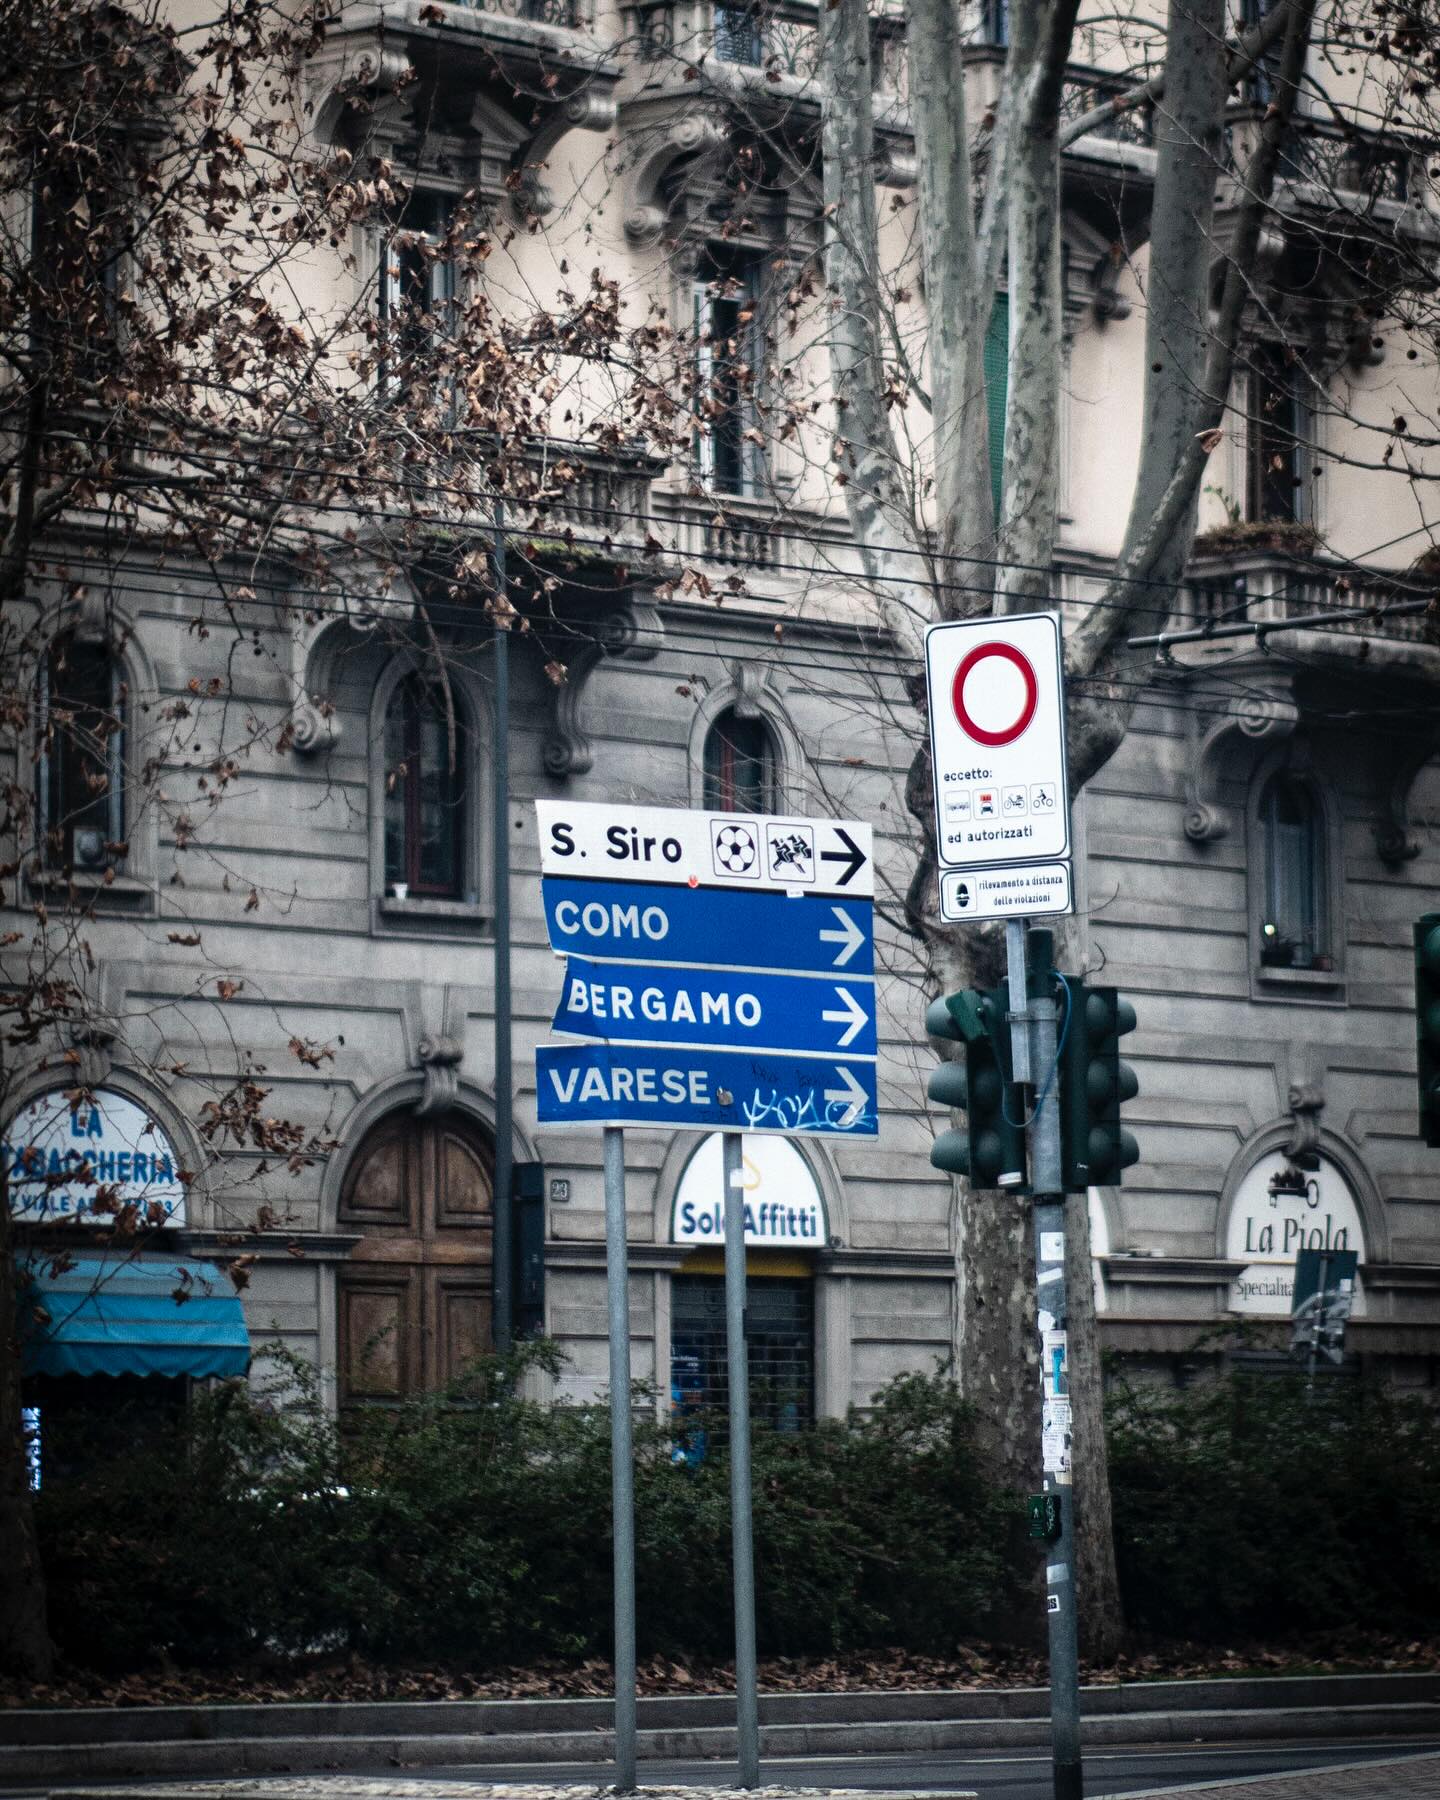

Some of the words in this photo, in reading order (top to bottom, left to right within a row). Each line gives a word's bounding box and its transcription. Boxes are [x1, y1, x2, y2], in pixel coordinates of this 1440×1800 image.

[943, 768, 993, 782] eccetto:
[550, 821, 588, 858] S.
[605, 825, 683, 863] Siro
[947, 832, 962, 844] ed
[967, 824, 1033, 842] autorizzati
[979, 877, 1024, 890] rilevamento
[1025, 879, 1031, 887] a
[1031, 875, 1064, 886] distanza
[993, 895, 1013, 906] delle
[1014, 891, 1051, 904] violazioni
[554, 899, 669, 941] COMO
[567, 977, 762, 1028] BERGAMO
[549, 1066, 712, 1105] VARESE
[70, 1107, 103, 1137] LA
[681, 1202, 726, 1235] Sol
[743, 1203, 817, 1238] Affitti
[1243, 1216, 1274, 1254] La
[1282, 1213, 1349, 1254] Piola
